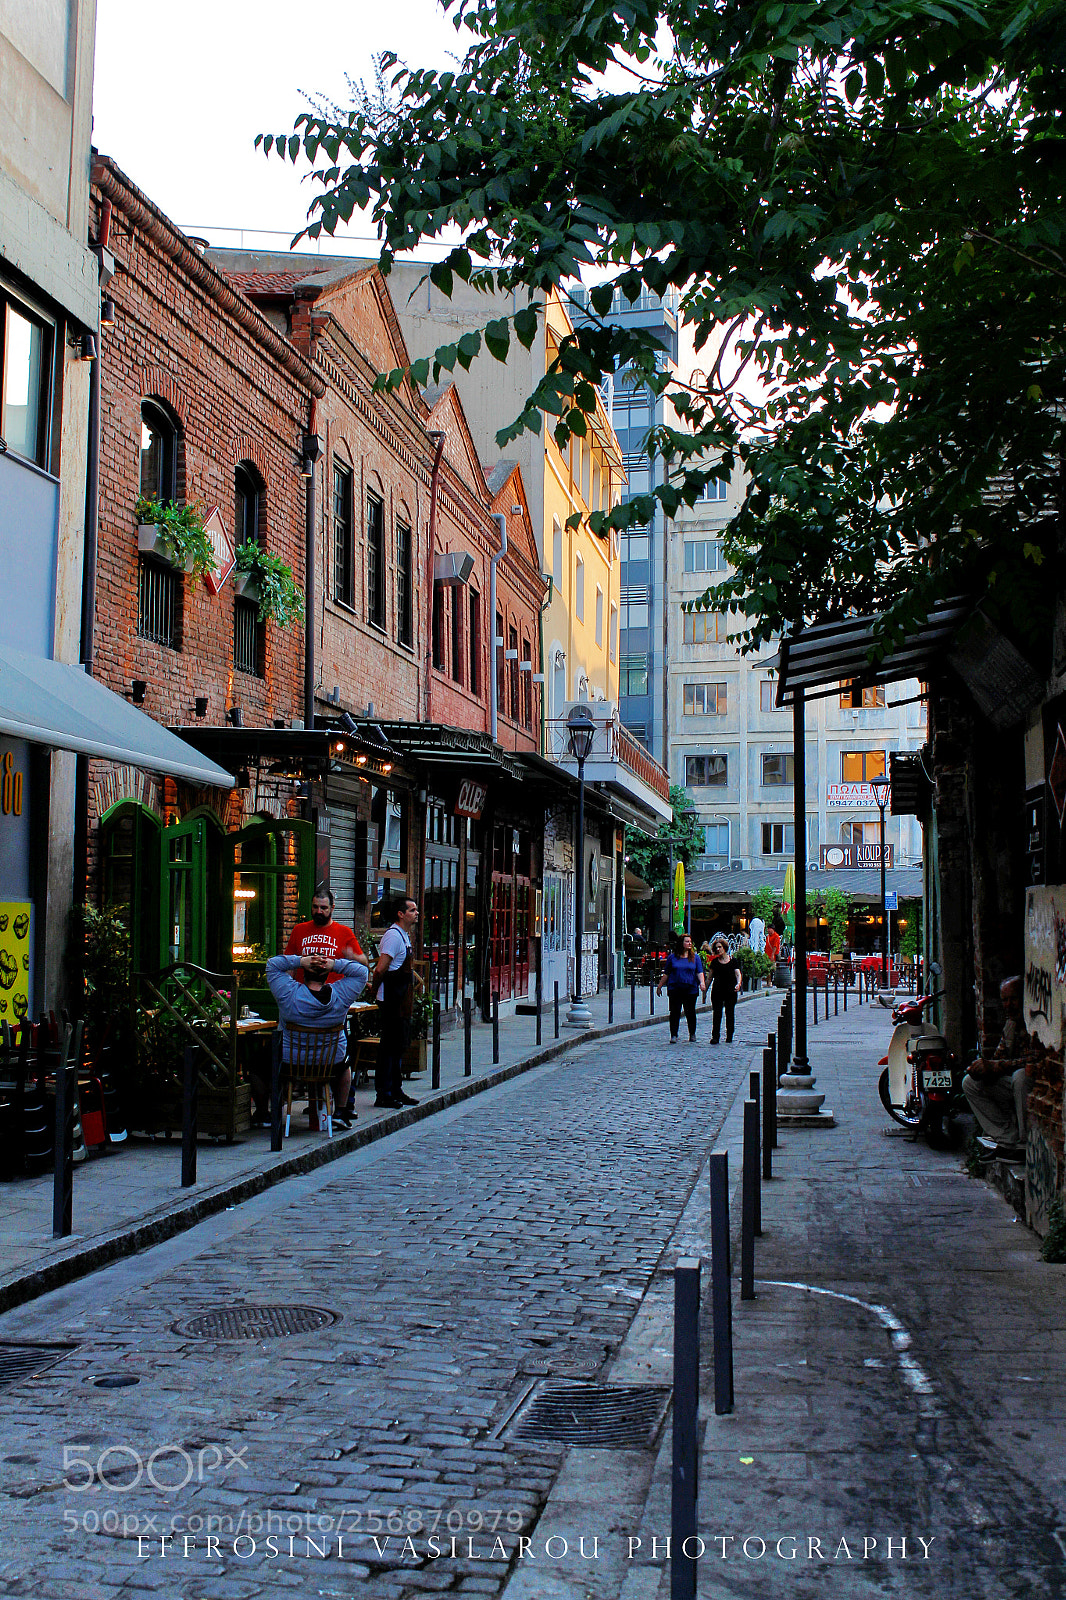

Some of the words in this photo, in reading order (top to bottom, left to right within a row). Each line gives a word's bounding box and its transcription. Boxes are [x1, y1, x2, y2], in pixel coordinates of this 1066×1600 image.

[458, 781, 482, 814] CLUB
[301, 934, 338, 948] RUSSELL
[302, 946, 337, 957] ATHLETIC
